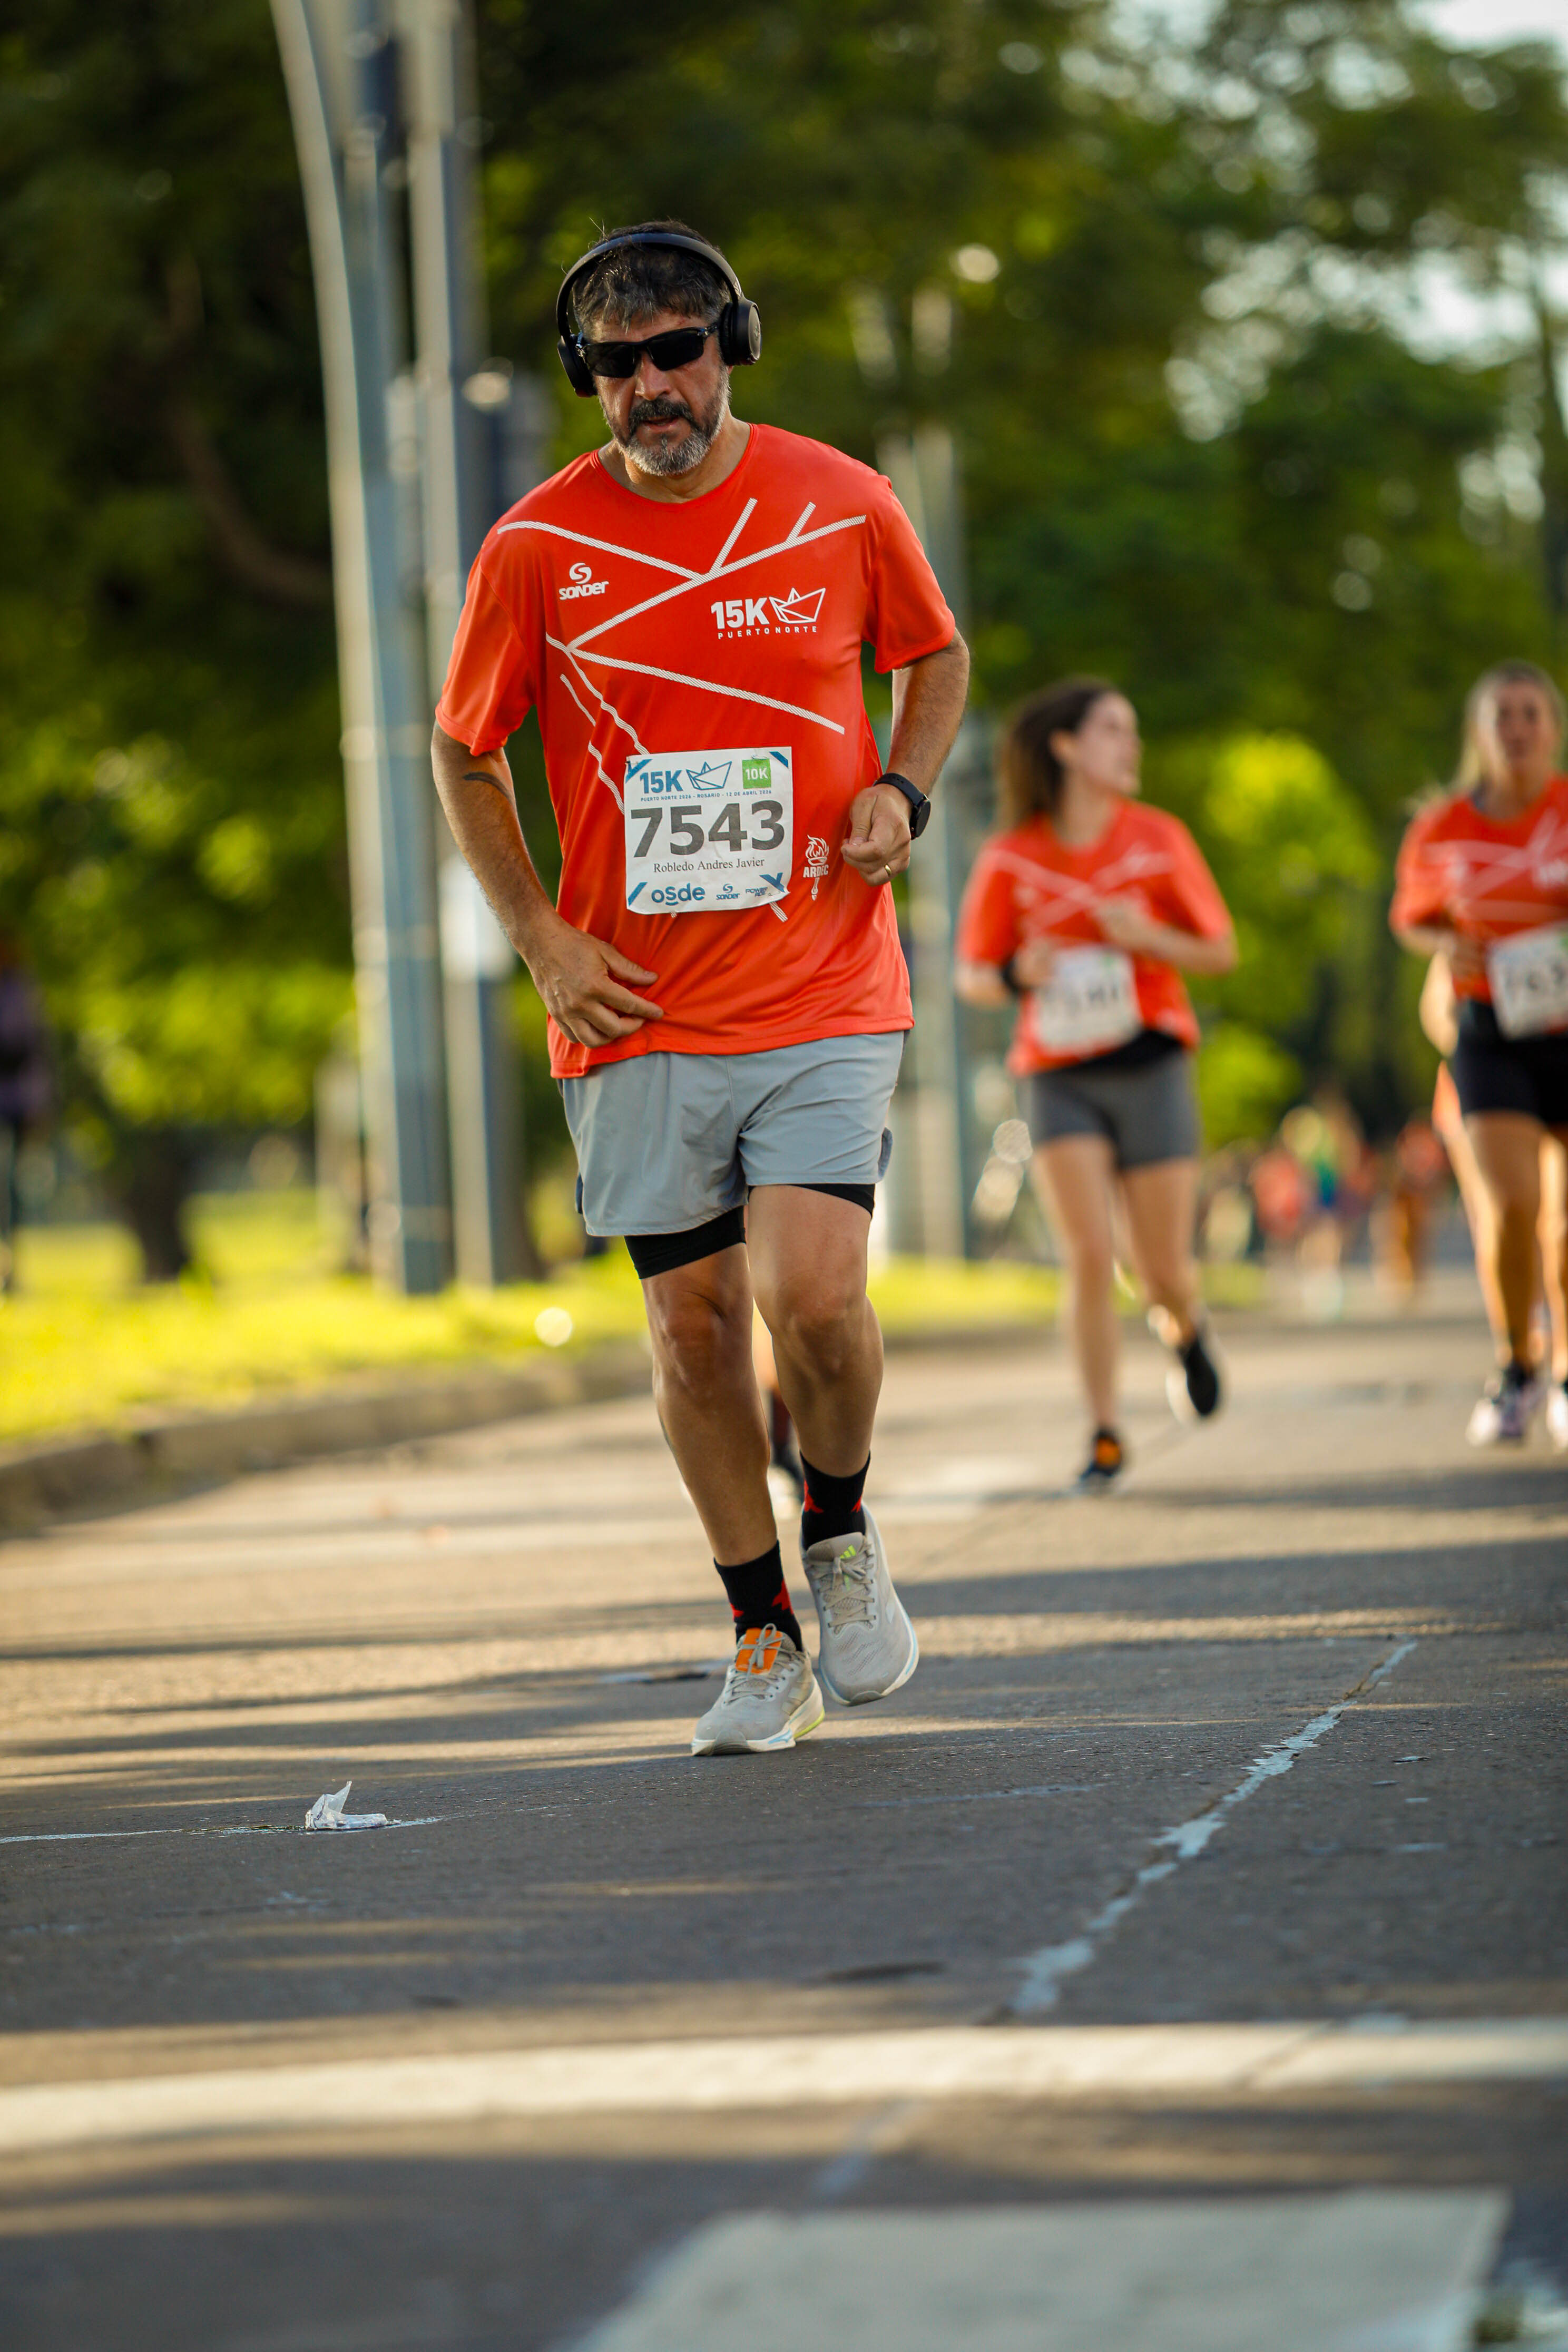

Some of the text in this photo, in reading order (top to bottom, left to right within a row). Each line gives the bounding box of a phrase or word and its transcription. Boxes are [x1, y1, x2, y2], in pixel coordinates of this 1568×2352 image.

[711, 597, 770, 629] 15K
[718, 628, 770, 639] PUERTO
[640, 770, 683, 793] 15K
[746, 767, 768, 780] 10K
[631, 800, 785, 858] 7543
[653, 857, 765, 873] Robledo Andres Javier
[803, 865, 829, 878] ARDEC
[651, 882, 705, 906] osde
